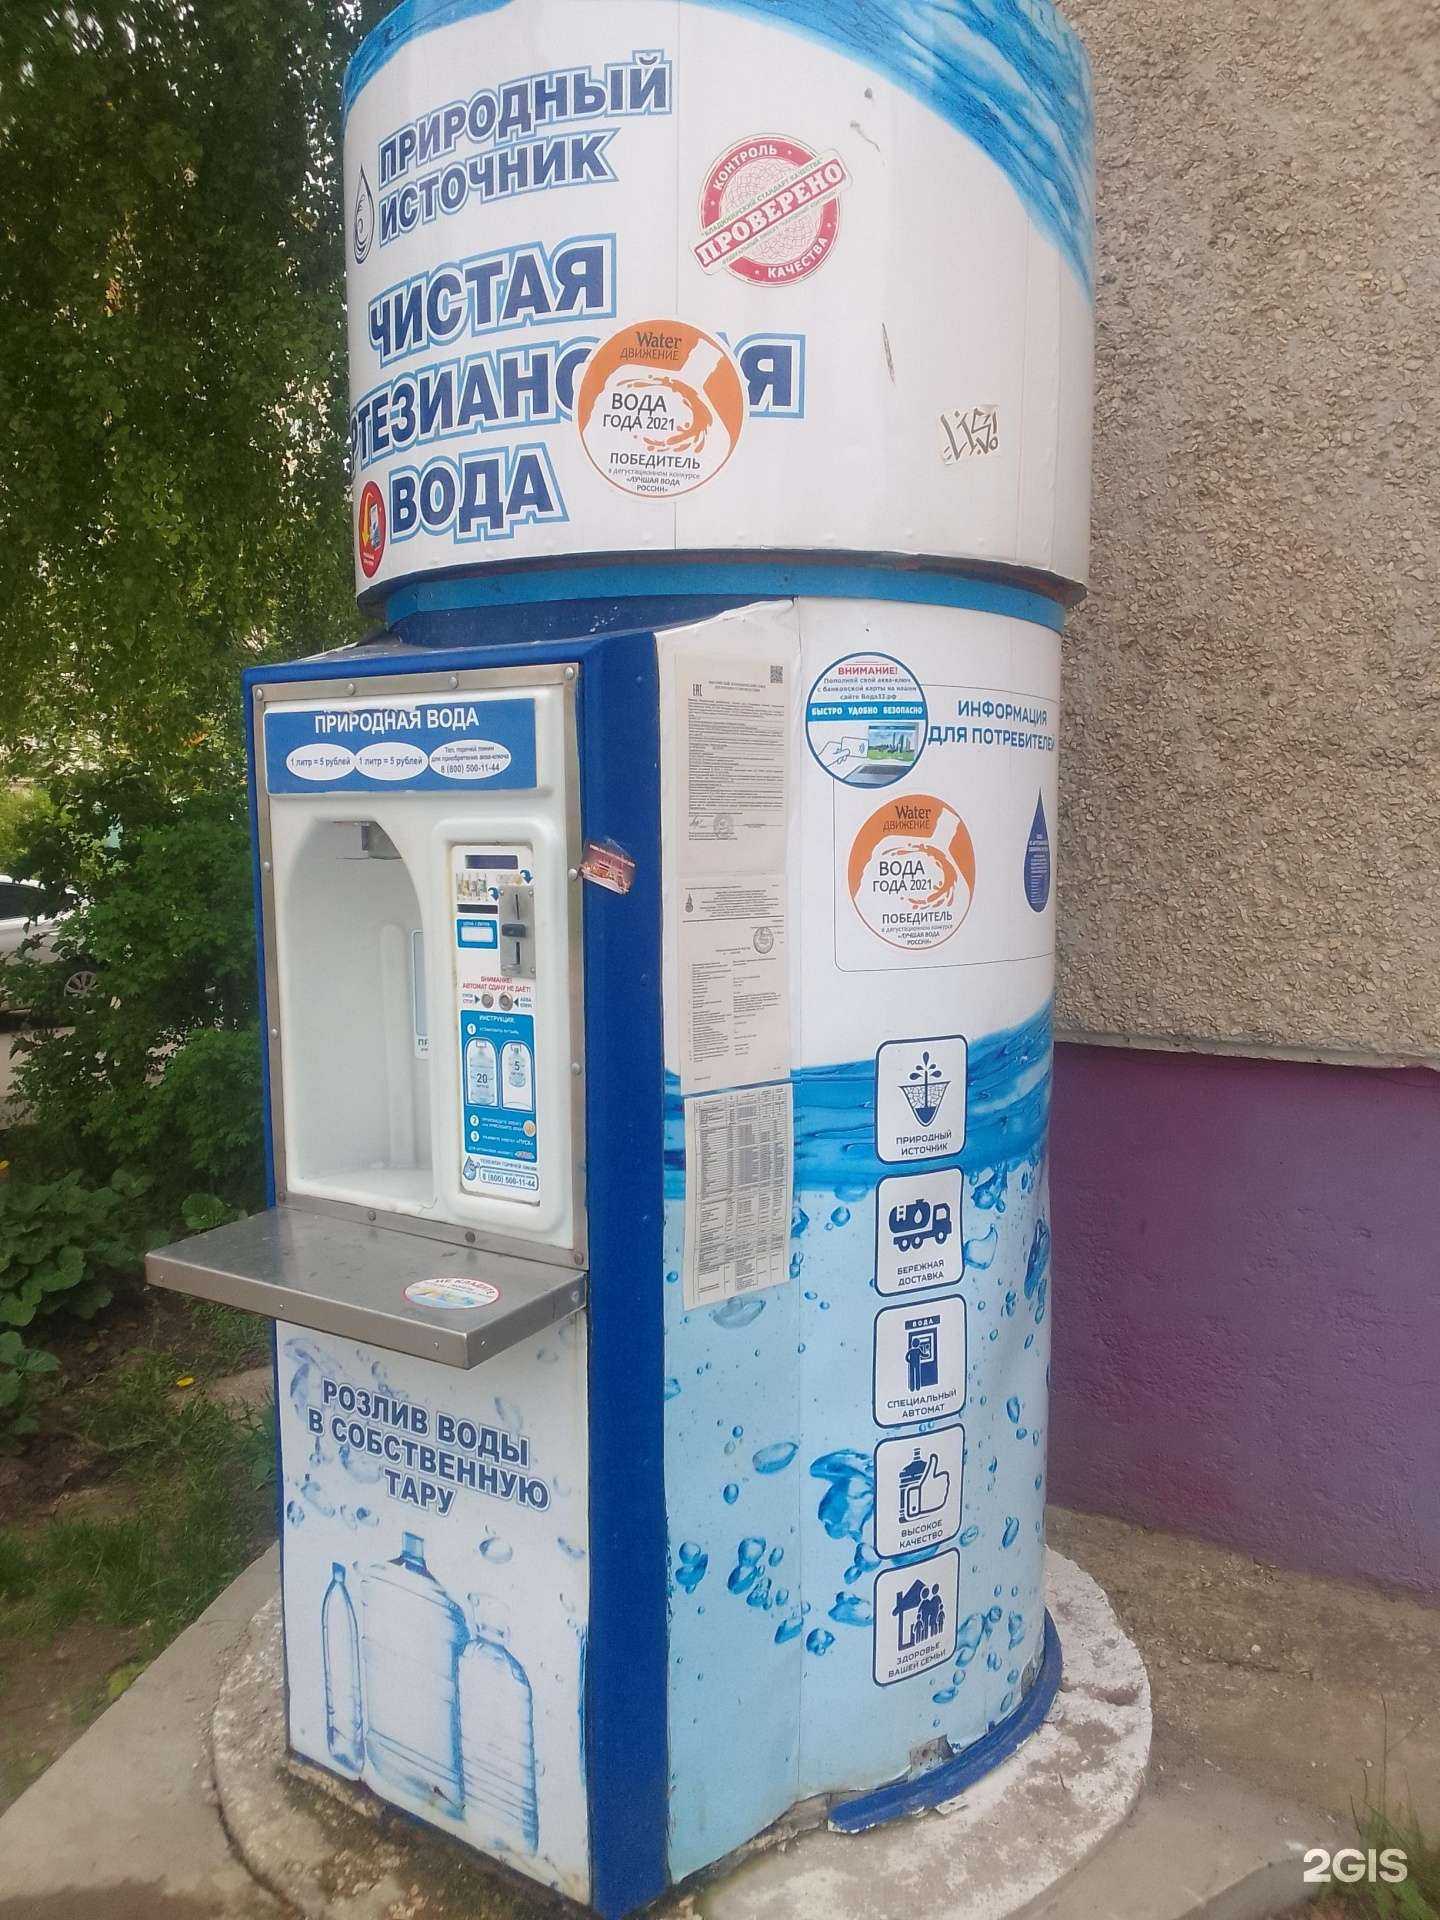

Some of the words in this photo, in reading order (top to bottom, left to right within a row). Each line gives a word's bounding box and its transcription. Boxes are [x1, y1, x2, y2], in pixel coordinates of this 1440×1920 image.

[380, 53, 669, 187] ПРИРОДНЫЙ
[713, 145, 777, 190] КОНТРОЛЬ
[380, 131, 616, 244] ИСТОЧНИК
[697, 164, 842, 264] ПРОВЕРЕНО
[768, 237, 828, 277] КАЧЕСТВА
[369, 240, 611, 360] ЧИСТАЯ
[636, 332, 682, 348] Water
[620, 347, 679, 360] ДВИЖЕНИЕ
[612, 393, 667, 415] ВОДА
[603, 414, 642, 431] ГОДА
[647, 417, 674, 431] 2021
[610, 453, 700, 469] ПОБЕДИТЕЛЬ
[660, 479, 680, 487] ВОДА
[391, 448, 562, 538] ВОДА
[838, 666, 898, 675] ВНИМАНИЕ!
[812, 707, 843, 716] БЫСТРО
[848, 706, 878, 716] УДОБНО
[883, 706, 923, 715] БЕЗОПАСНО
[958, 700, 1047, 726] ИНФОРМАЦИЯ
[314, 709, 421, 734] ПРИРОДНАЯ
[427, 707, 479, 731] ВОДА
[928, 725, 967, 745] ДЛЯ
[320, 758, 324, 766] 5
[325, 756, 350, 767] рублей
[364, 758, 382, 766] литр
[390, 757, 394, 765] 5
[397, 756, 423, 766] рублей
[895, 805, 931, 819] Water
[883, 820, 930, 831] ДВИЖЕНИЕ
[880, 860, 925, 879] ВОДА
[873, 880, 907, 895] ГОДА
[910, 879, 932, 891] 2021
[882, 911, 953, 925] ПОБЕДИТЕЛЬ
[514, 1061, 520, 1071] 5
[476, 1073, 488, 1084] 20
[896, 1129, 952, 1145] ПРИРОДНЫЙ
[901, 1143, 948, 1155] ИСТОЧНИК
[897, 1259, 944, 1275] БЕРЕЖНАЯ
[898, 1271, 944, 1286] ДОСТАВКА
[913, 1318, 934, 1327] ВОДА
[887, 1389, 957, 1408] СПЕЦИАЛЬНЫЙ
[902, 1403, 945, 1418] АВТОМАТ
[323, 1379, 428, 1434] РОЗЛИВ
[437, 1413, 528, 1466] ВОДЫ
[308, 1409, 324, 1434] В
[331, 1417, 548, 1508] СОБСТВЕННУЮ
[384, 1468, 454, 1515] ТАРУ
[901, 1520, 942, 1537] ВЫСОКОЕ
[899, 1530, 943, 1548] КАЧЕСТВО
[896, 1641, 941, 1665] ЗДОРОВЬЕ
[888, 1660, 919, 1678] ВАШЕЙ
[920, 1649, 946, 1666] СЕМЬИ
